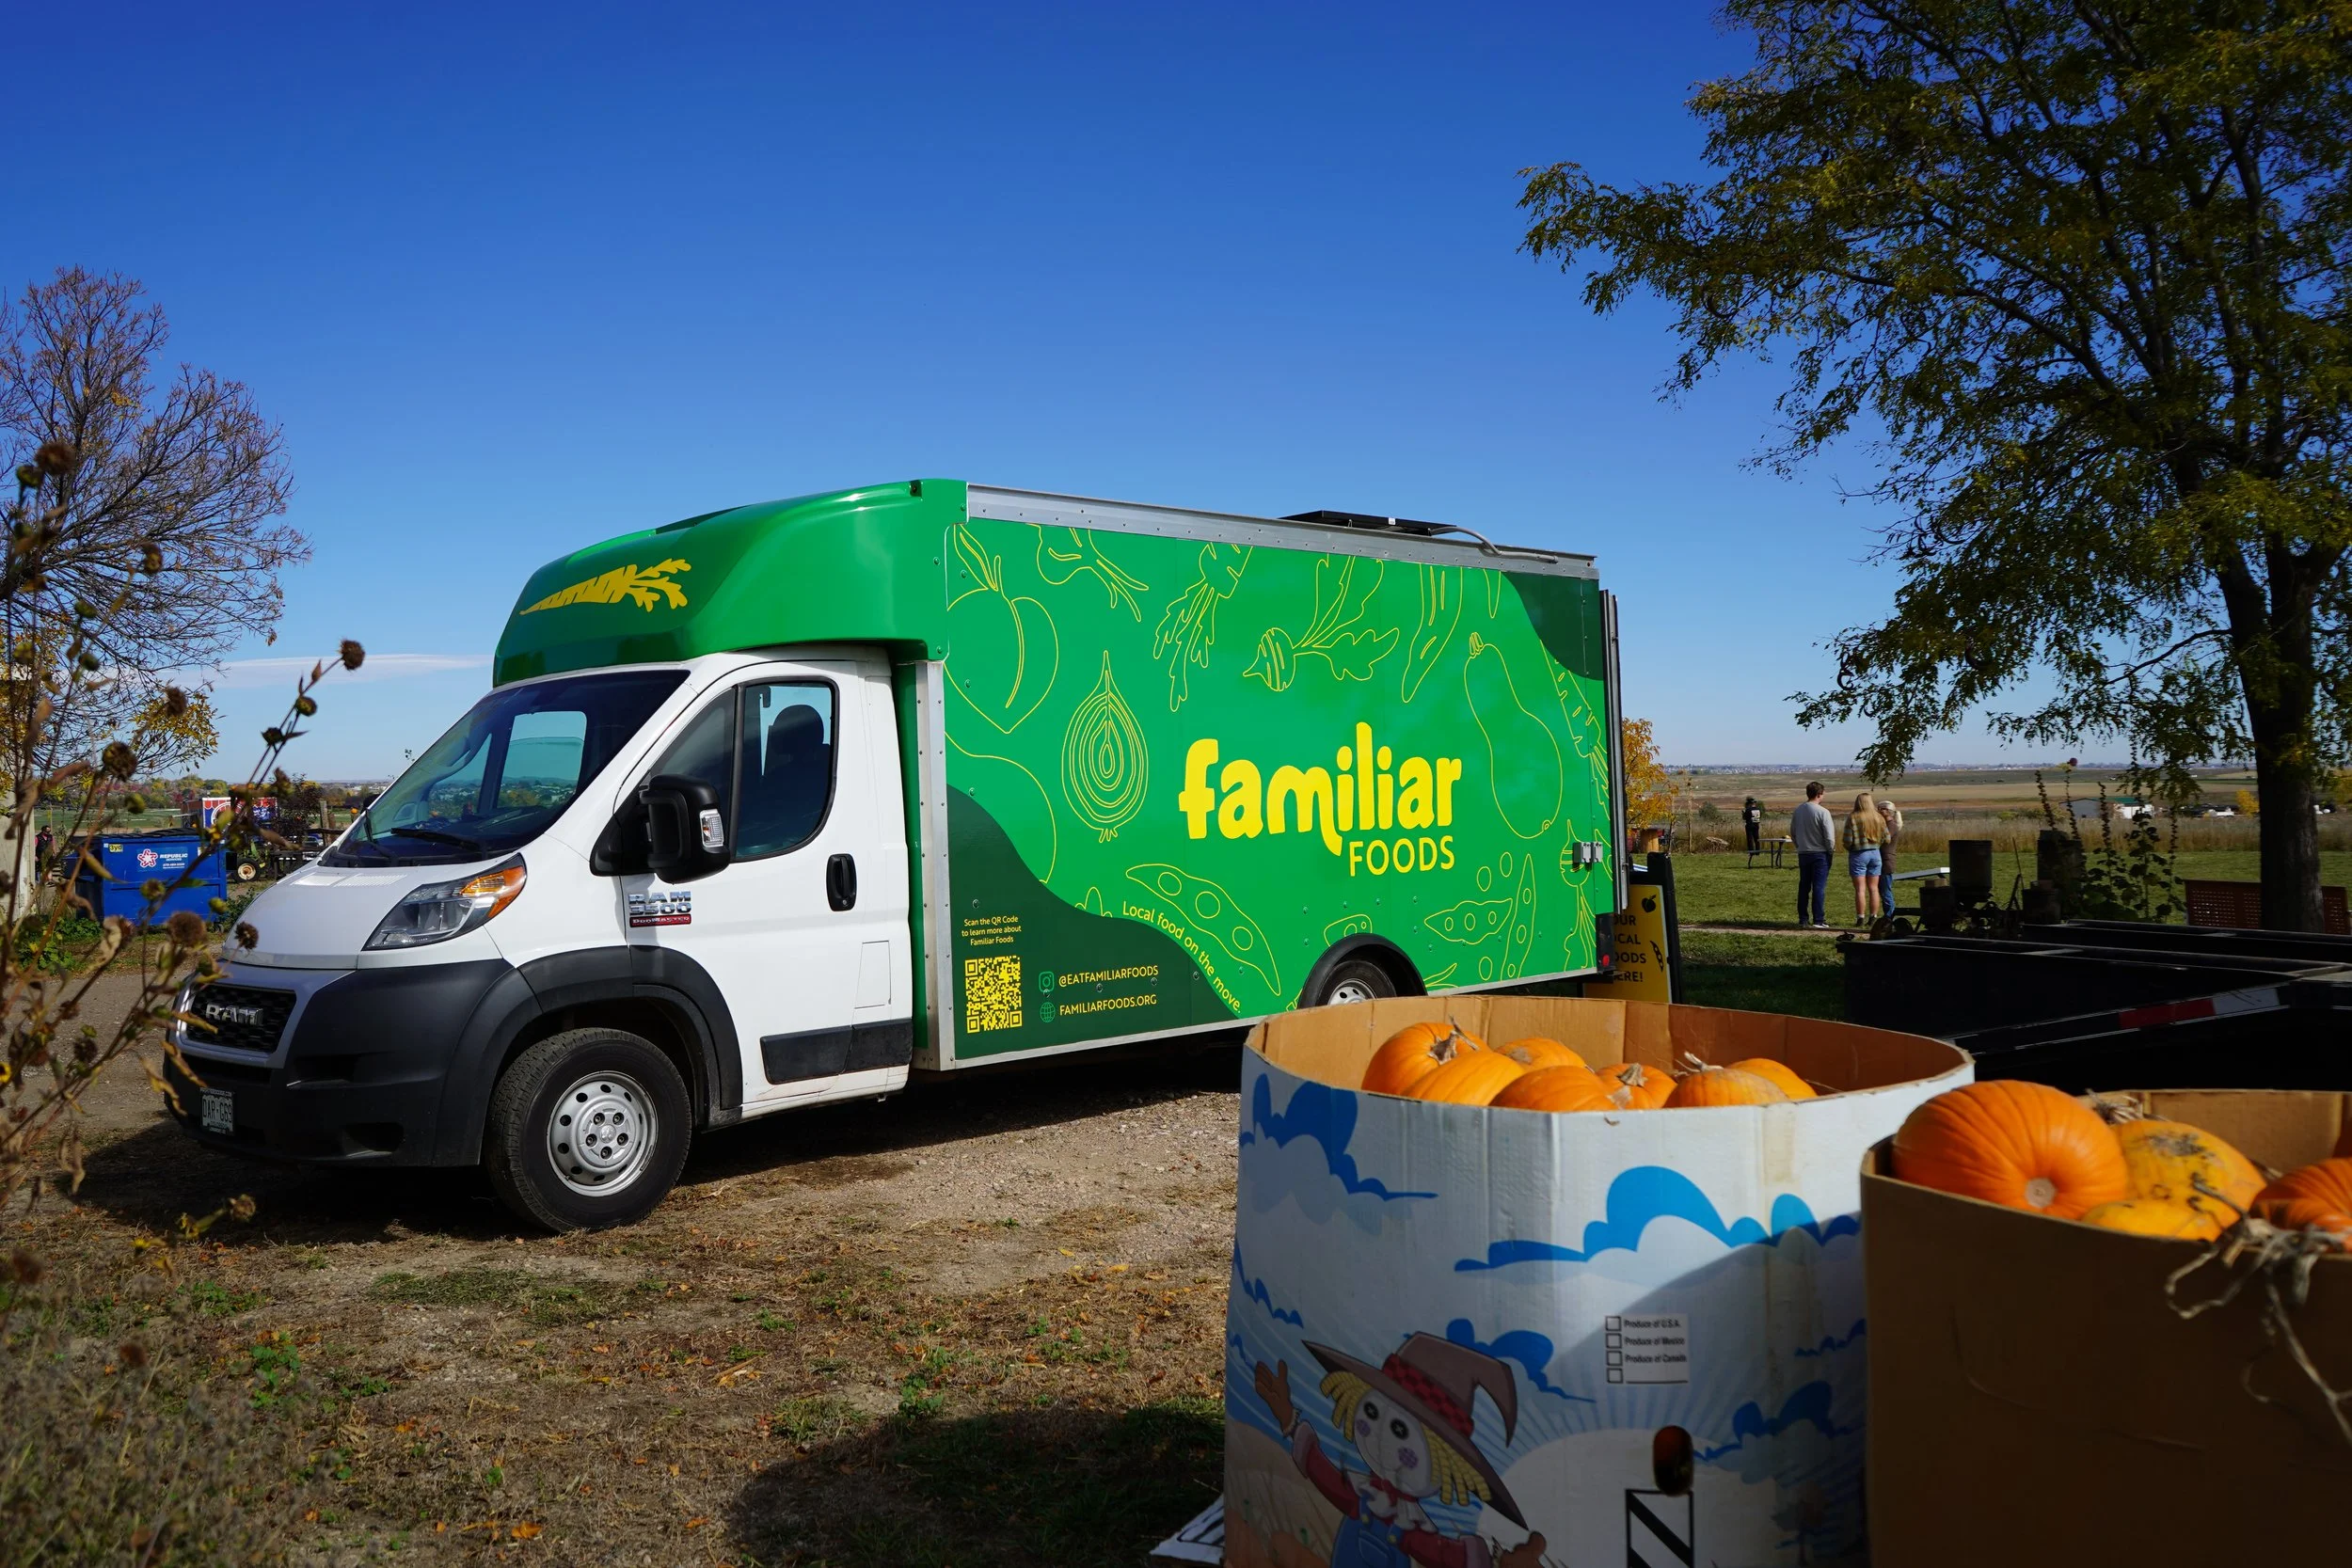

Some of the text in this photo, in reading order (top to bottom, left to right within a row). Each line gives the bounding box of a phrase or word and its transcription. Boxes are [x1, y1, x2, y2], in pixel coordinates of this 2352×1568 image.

[1178, 721, 1462, 856] familiar
[1349, 835, 1455, 877] FOODS
[628, 891, 691, 904] RAM
[629, 902, 692, 915] 3500
[963, 918, 979, 927] Scan
[991, 916, 1002, 926] QR
[1002, 915, 1019, 924] Code
[970, 935, 1014, 946] Familiar Foods
[1122, 900, 1241, 1014] Local food on the move.
[1058, 965, 1159, 988] @EATFAMILIARFOODS
[1613, 971, 1644, 982] ERE!
[1059, 994, 1157, 1016] FAMILIARFOODS.ORG
[205, 1003, 263, 1025] RAM
[1624, 1319, 1651, 1328] Produce
[1652, 1319, 1661, 1328] of
[1624, 1337, 1652, 1345] Produce
[1653, 1337, 1661, 1345] of
[1625, 1353, 1687, 1363] Produce of Canada
